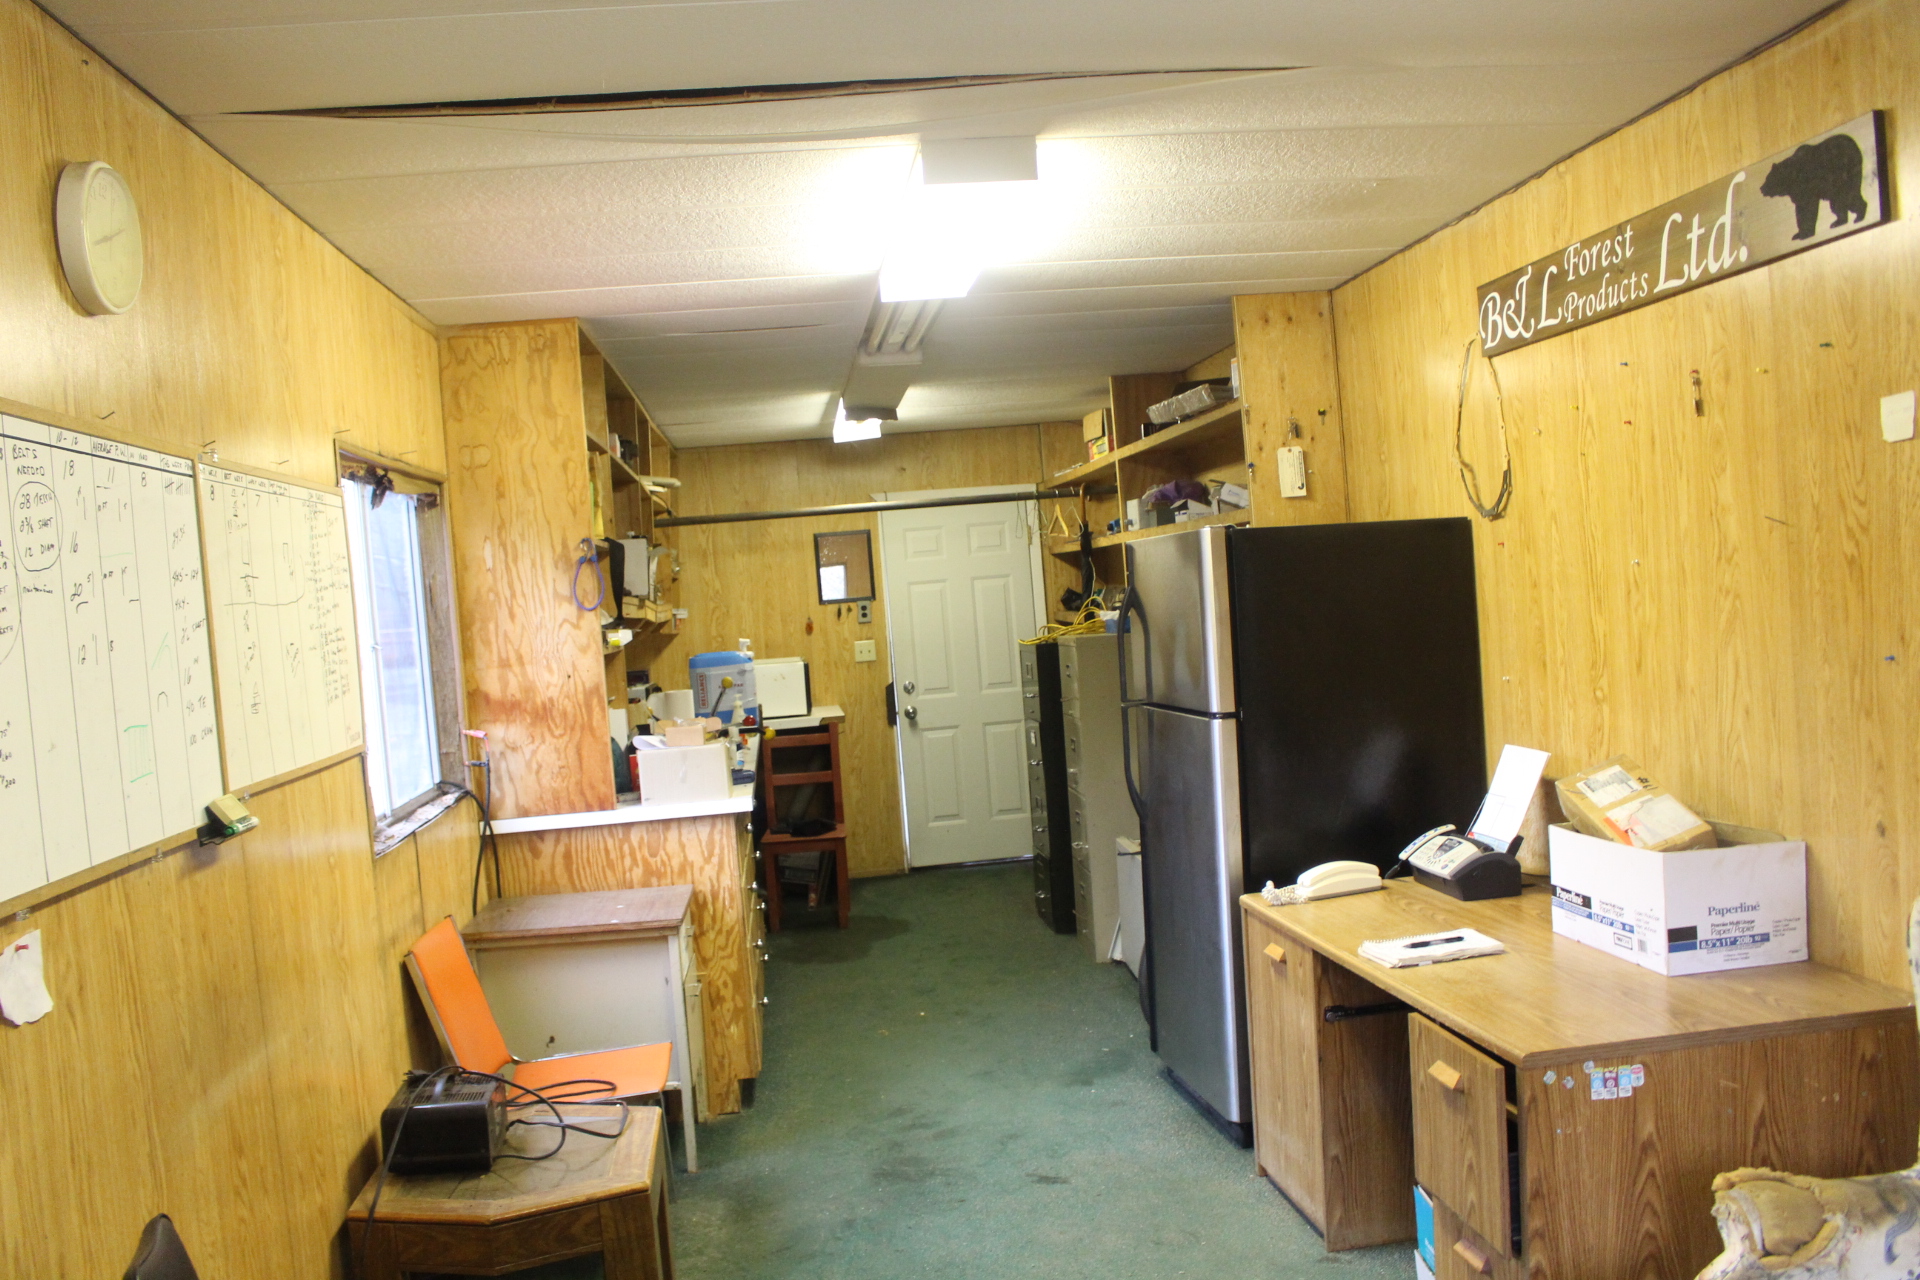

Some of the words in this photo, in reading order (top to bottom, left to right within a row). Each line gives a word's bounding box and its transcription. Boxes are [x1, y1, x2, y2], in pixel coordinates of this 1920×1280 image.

[1564, 224, 1634, 282] Forest
[1654, 170, 1748, 294] Ltd.
[1564, 271, 1649, 324] Products
[698, 674, 707, 707] RELIANCE
